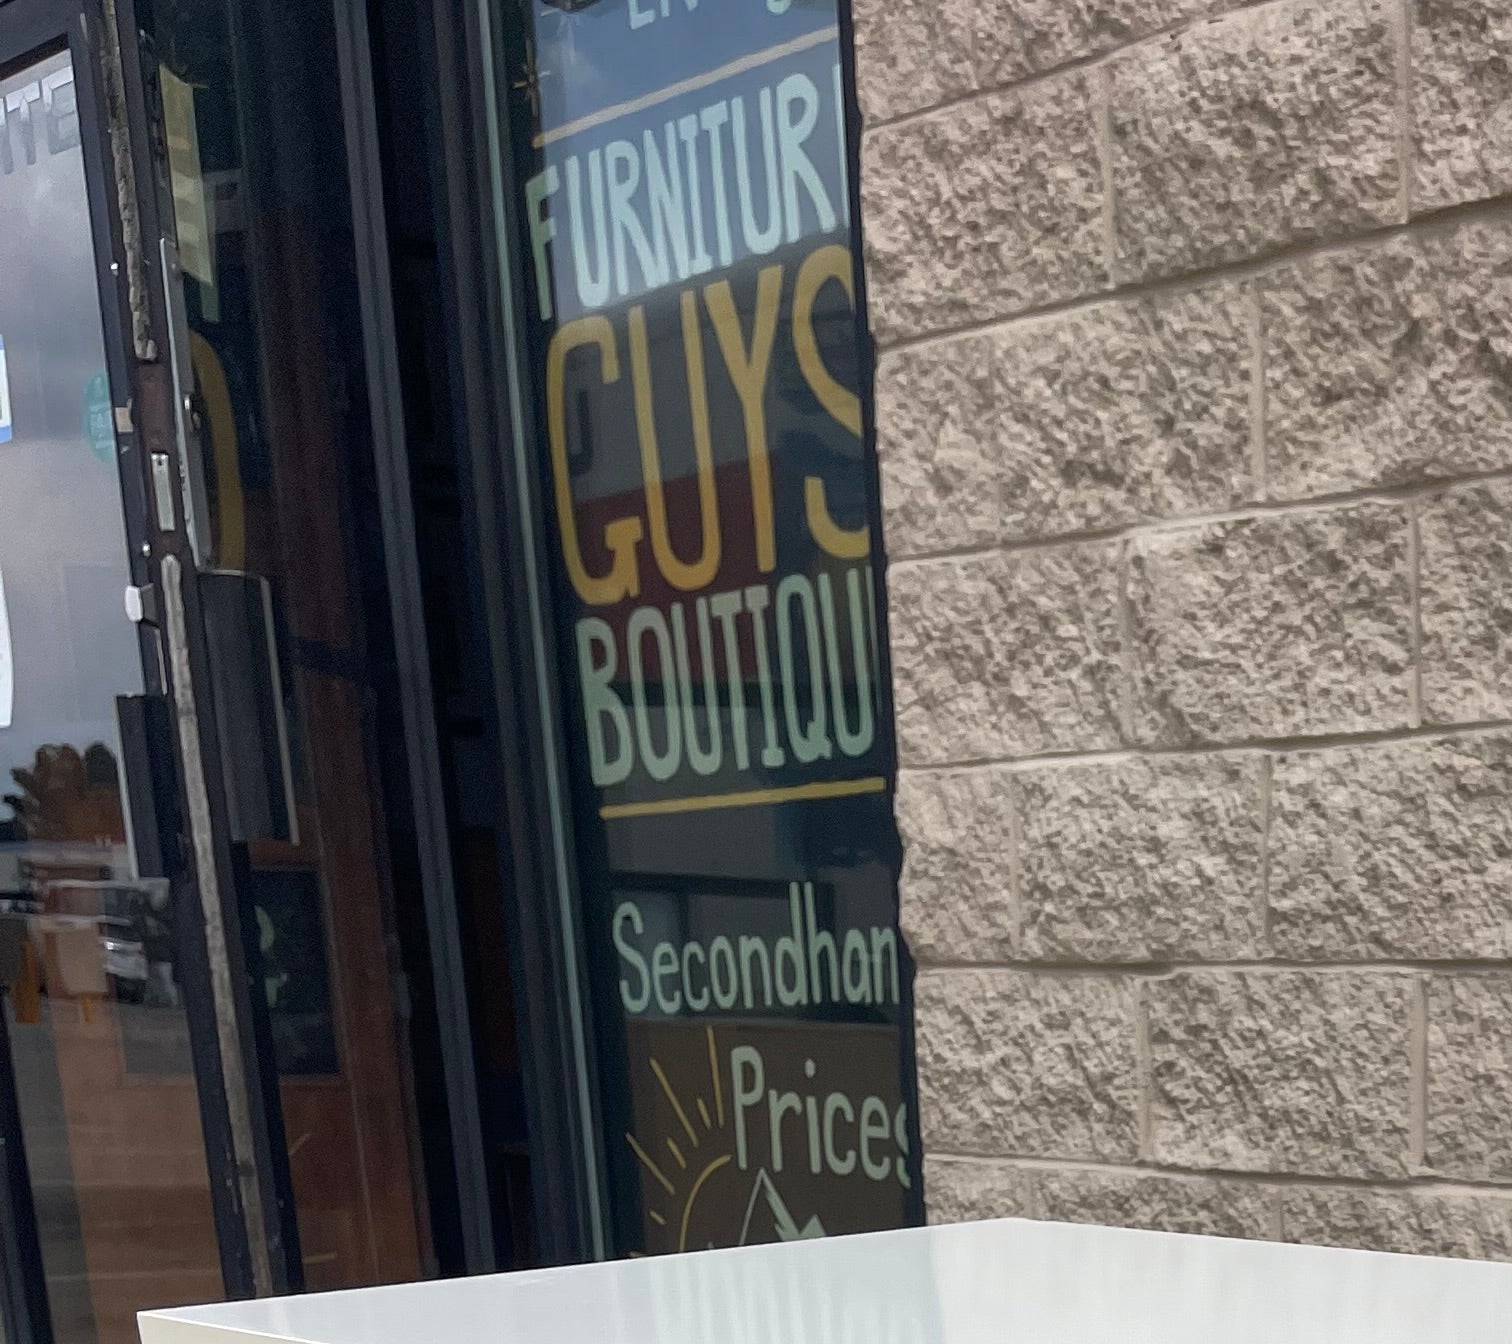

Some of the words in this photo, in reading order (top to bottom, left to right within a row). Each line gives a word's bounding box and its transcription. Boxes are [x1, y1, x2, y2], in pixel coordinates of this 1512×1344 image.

[525, 64, 849, 321] FURNITUR
[546, 245, 870, 604] GUYS
[576, 567, 882, 786] BOUTIQU
